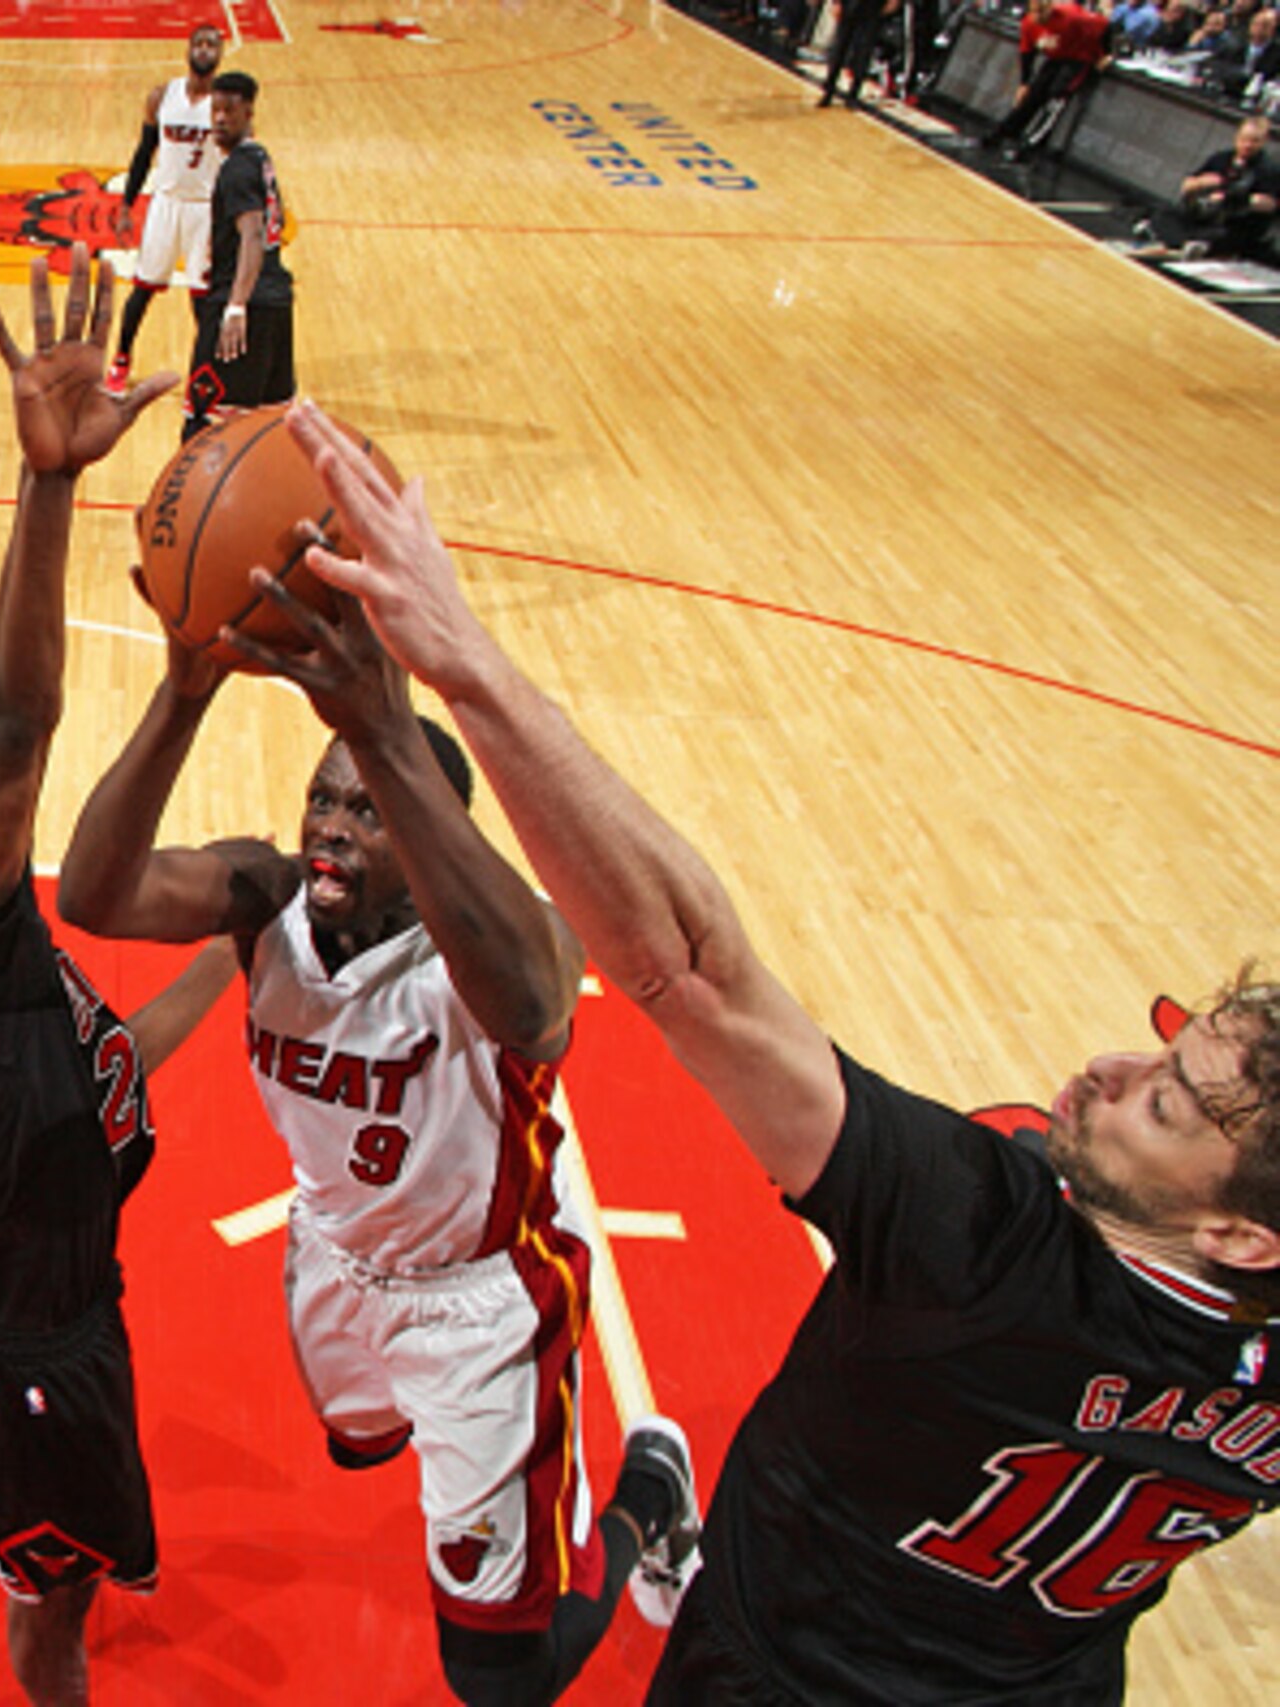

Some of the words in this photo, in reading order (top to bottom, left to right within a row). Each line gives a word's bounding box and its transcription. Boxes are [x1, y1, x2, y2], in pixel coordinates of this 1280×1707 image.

[529, 99, 663, 186] CENTER
[608, 102, 758, 190] UNITED
[246, 1012, 440, 1117] HEAT
[348, 1122, 410, 1187] 9
[895, 1441, 1264, 1618] 16
